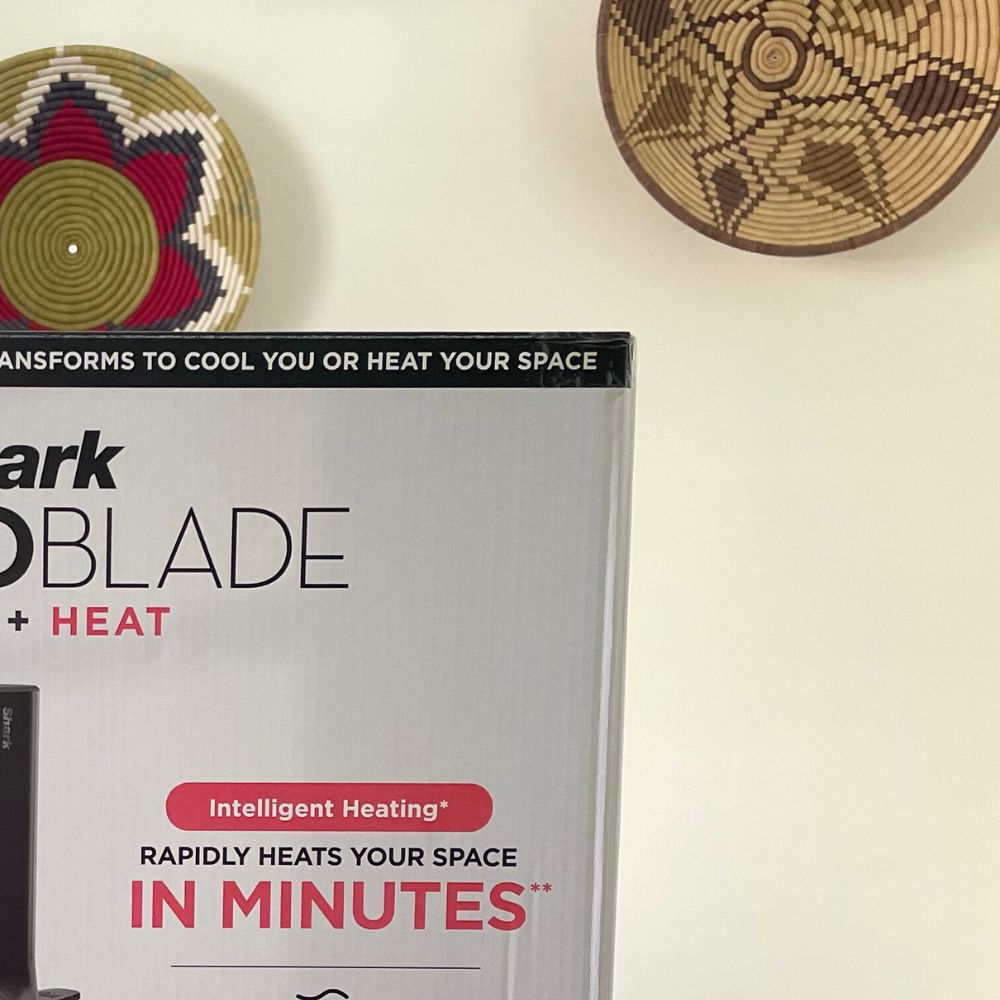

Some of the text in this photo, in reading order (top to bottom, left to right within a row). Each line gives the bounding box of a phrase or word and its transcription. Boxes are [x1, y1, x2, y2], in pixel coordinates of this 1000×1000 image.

[143, 351, 176, 371] TO
[184, 351, 254, 371] COOL
[262, 351, 314, 371] YOU
[322, 351, 359, 371] OR
[367, 351, 432, 371] HEAT
[440, 351, 510, 371] YOUR
[517, 351, 597, 371] SPACE
[8, 610, 29, 631] +
[52, 606, 170, 636] HEAT
[209, 799, 334, 821] Intelligent
[140, 847, 517, 867] RAPIDLY HEATS YOUR SPACE
[131, 881, 195, 929] IN
